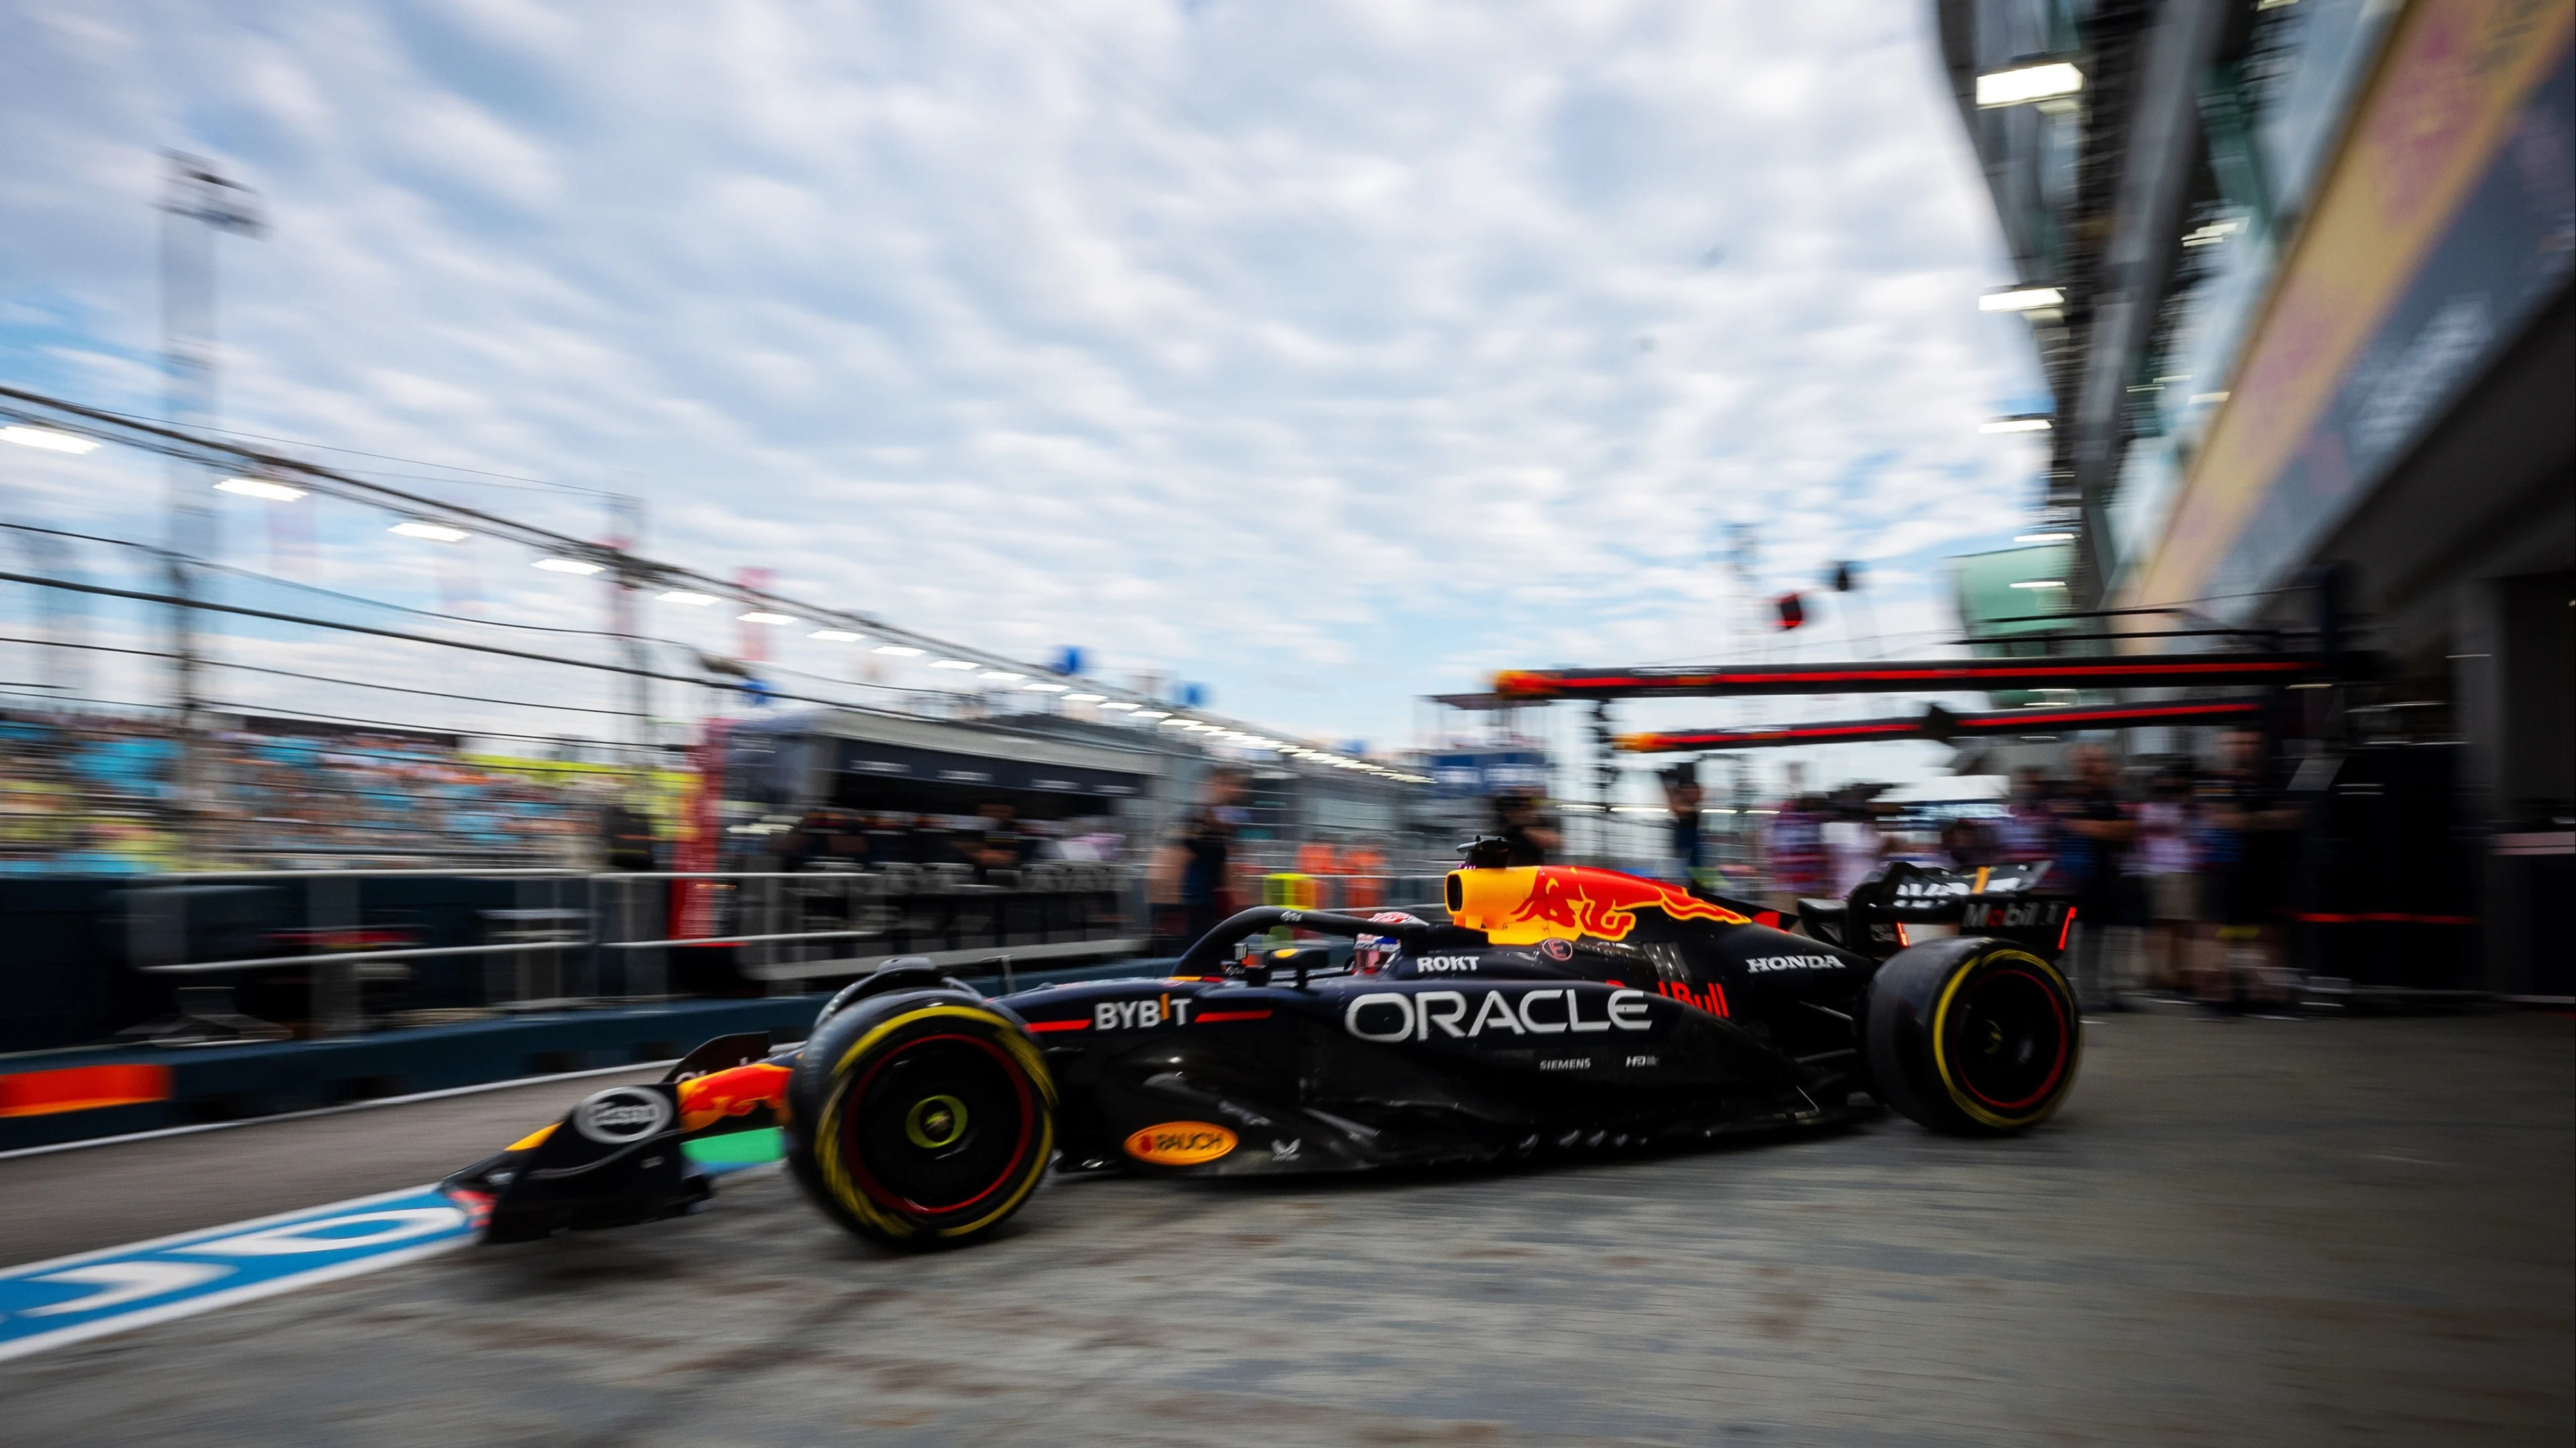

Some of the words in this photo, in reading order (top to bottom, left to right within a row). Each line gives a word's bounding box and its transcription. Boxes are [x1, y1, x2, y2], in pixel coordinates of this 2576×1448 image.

[1548, 940, 1566, 958] E
[1417, 956, 1480, 972] ROKT
[1746, 955, 1846, 973] HONDA
[1095, 993, 1192, 1031] BYBIT
[1345, 989, 1653, 1043] ORACLE
[1540, 1058, 1591, 1070] SIEMENS
